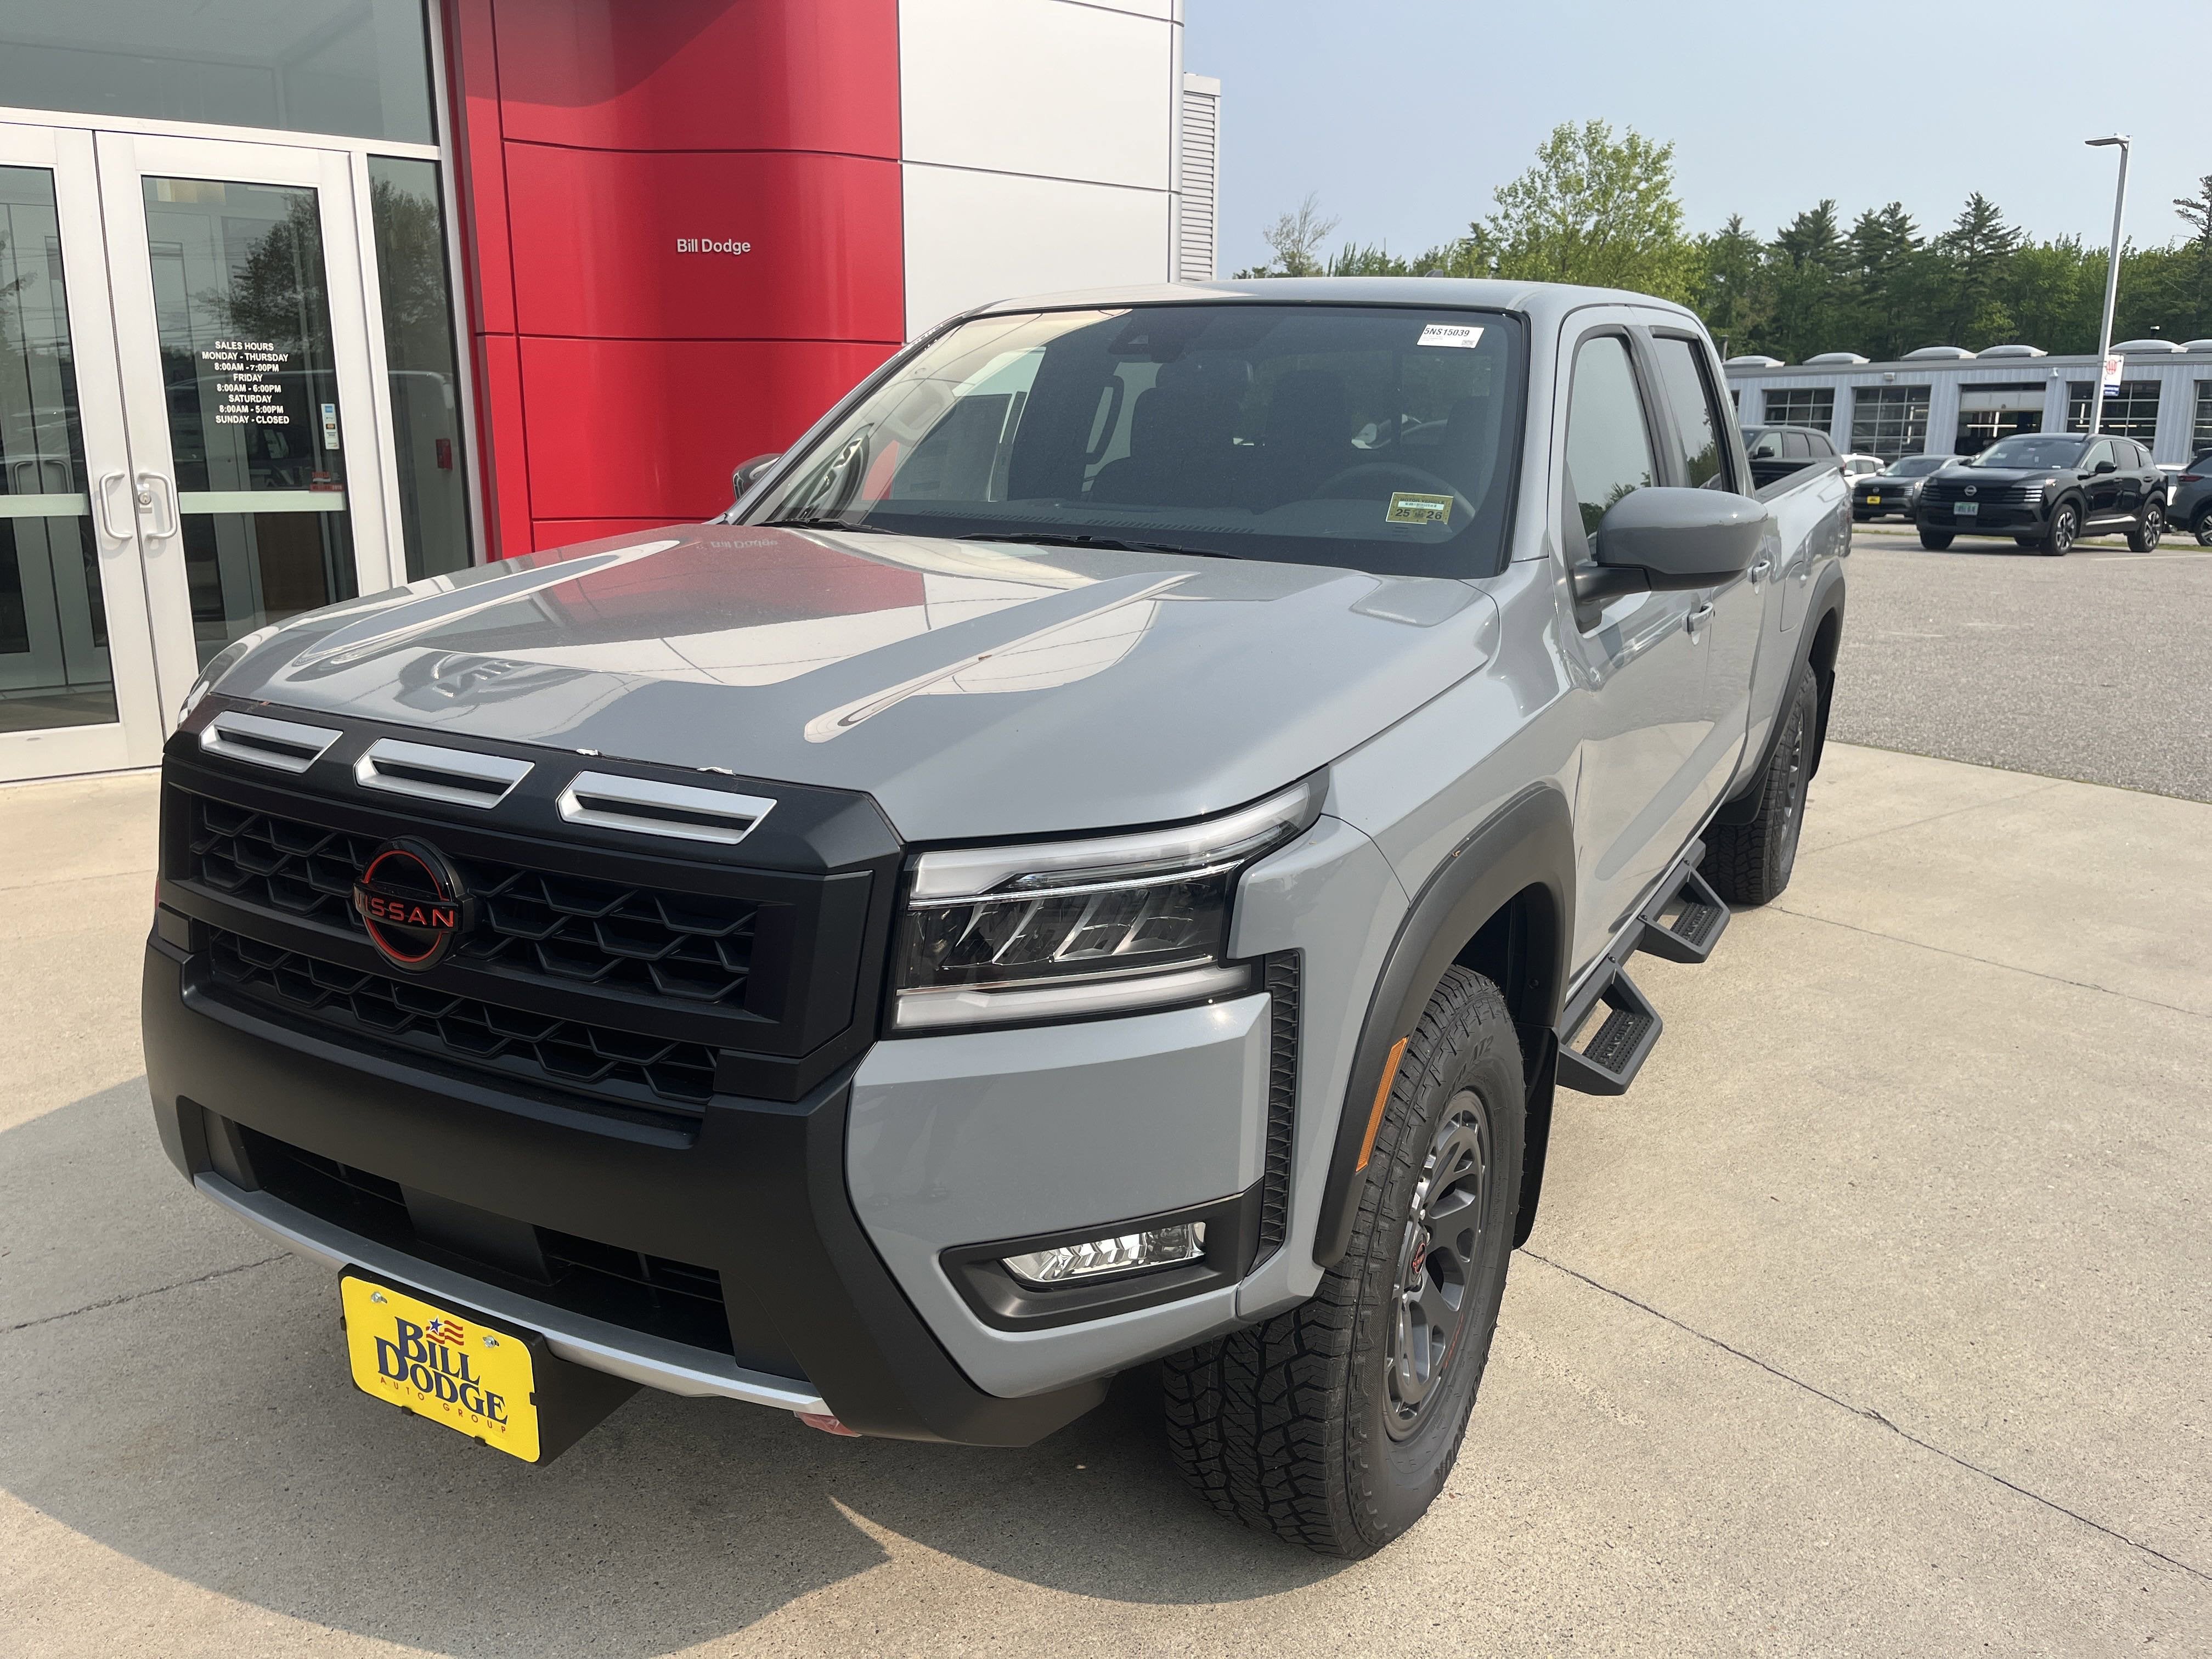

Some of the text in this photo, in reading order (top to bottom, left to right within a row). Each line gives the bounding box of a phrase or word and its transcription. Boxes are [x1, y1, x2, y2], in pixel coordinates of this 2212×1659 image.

[677, 238, 751, 255] Bill Dodge
[1424, 328, 1470, 337] 5NS15039
[215, 341, 274, 351] SALES HOURS
[201, 351, 238, 360] MONDAY
[244, 352, 289, 362] THURSDAY
[214, 362, 244, 371] 8:00AM
[250, 363, 279, 373] 7:00PM
[233, 373, 263, 382] FRIDAY
[216, 383, 246, 392] 8:00AM
[252, 384, 281, 393] 6:00PM
[228, 394, 272, 403] SATURDAY
[219, 404, 249, 413] 8:00AM
[255, 405, 284, 414] 5:00PM
[215, 415, 250, 424] SUNDAY
[256, 415, 290, 424] CLOSED
[1395, 508, 1410, 517] 25
[1426, 510, 1443, 520] 26
[354, 887, 454, 928] NISSAN
[394, 1316, 480, 1386] BILL
[374, 1336, 508, 1425] DODGE
[380, 1376, 506, 1434] AUTO GROUP
